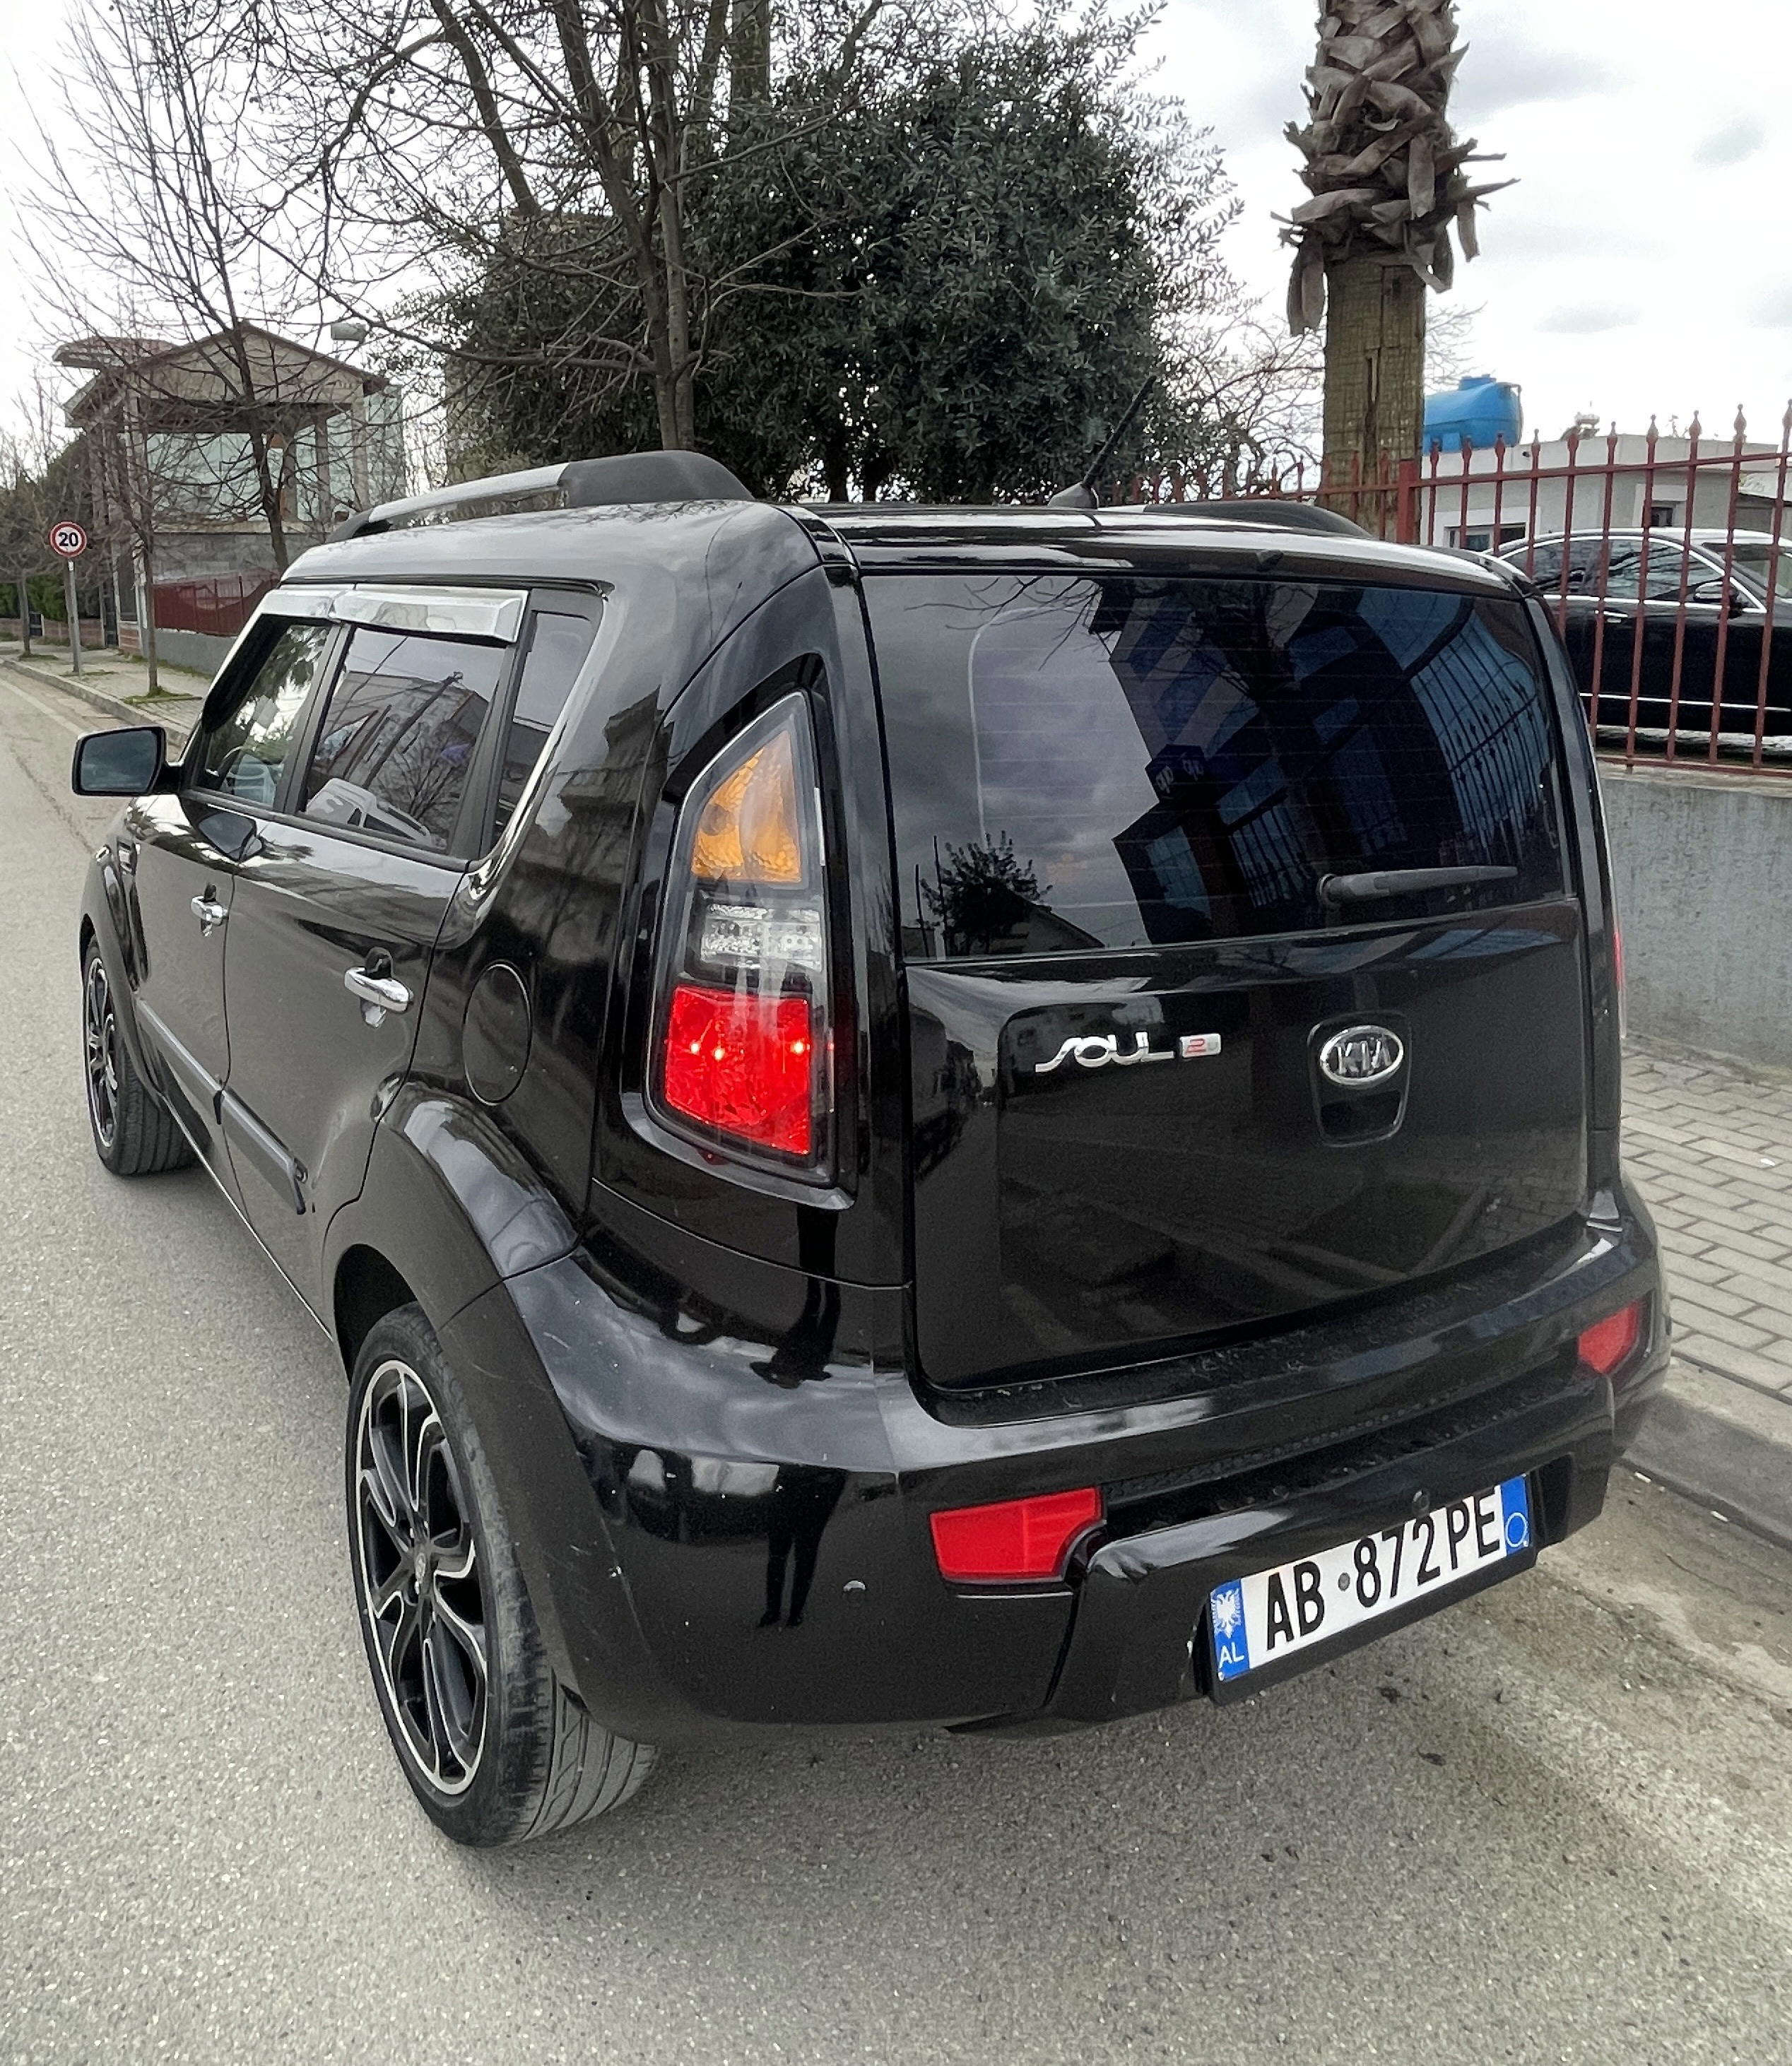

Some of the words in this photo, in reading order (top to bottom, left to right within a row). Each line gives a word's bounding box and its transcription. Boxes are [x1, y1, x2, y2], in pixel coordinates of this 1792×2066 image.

[59, 532, 78, 546] 20
[1035, 1032, 1174, 1073] SOUL
[1334, 1037, 1393, 1074] KIA
[1267, 1561, 1324, 1651] AB
[1219, 1641, 1244, 1668] AL
